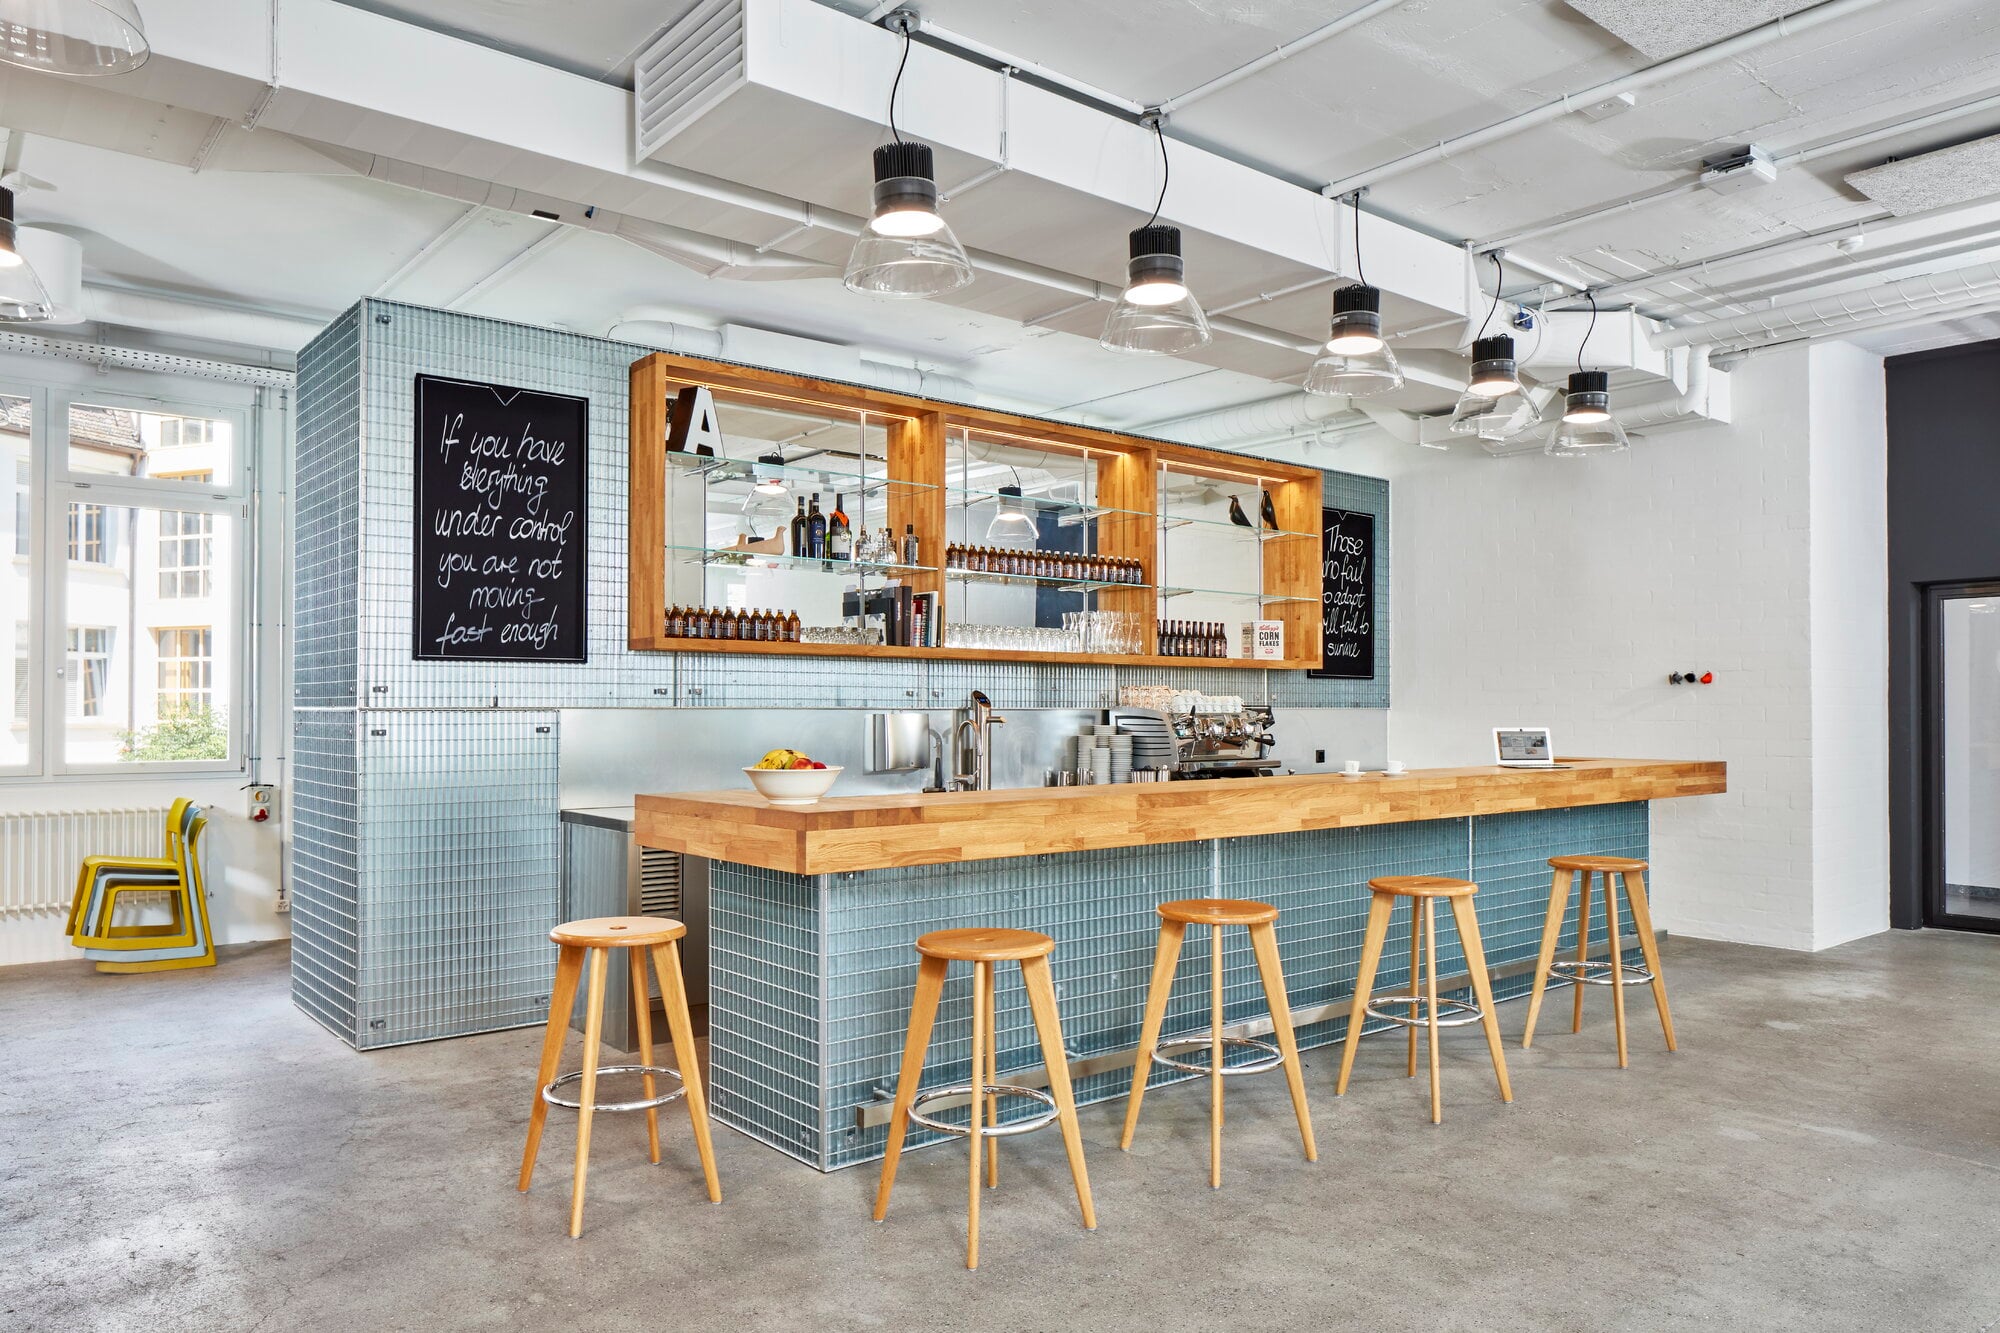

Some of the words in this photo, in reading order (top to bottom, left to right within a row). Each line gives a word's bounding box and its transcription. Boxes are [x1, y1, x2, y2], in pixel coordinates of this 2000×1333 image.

[440, 412, 464, 464] If
[470, 430, 511, 471] you
[517, 422, 566, 466] have
[683, 386, 726, 459] A
[435, 503, 503, 538] under
[509, 508, 574, 546] control
[1325, 523, 1364, 556] Those
[438, 551, 477, 589] you
[482, 554, 520, 576] are
[528, 548, 562, 580] not
[1341, 554, 1367, 590] fail
[469, 577, 545, 620] moving
[1333, 586, 1367, 614] adapt
[435, 612, 493, 655] fast
[500, 604, 558, 650] enough
[1259, 631, 1280, 641] CORN
[1340, 610, 1358, 638] fail
[1359, 611, 1369, 635] to
